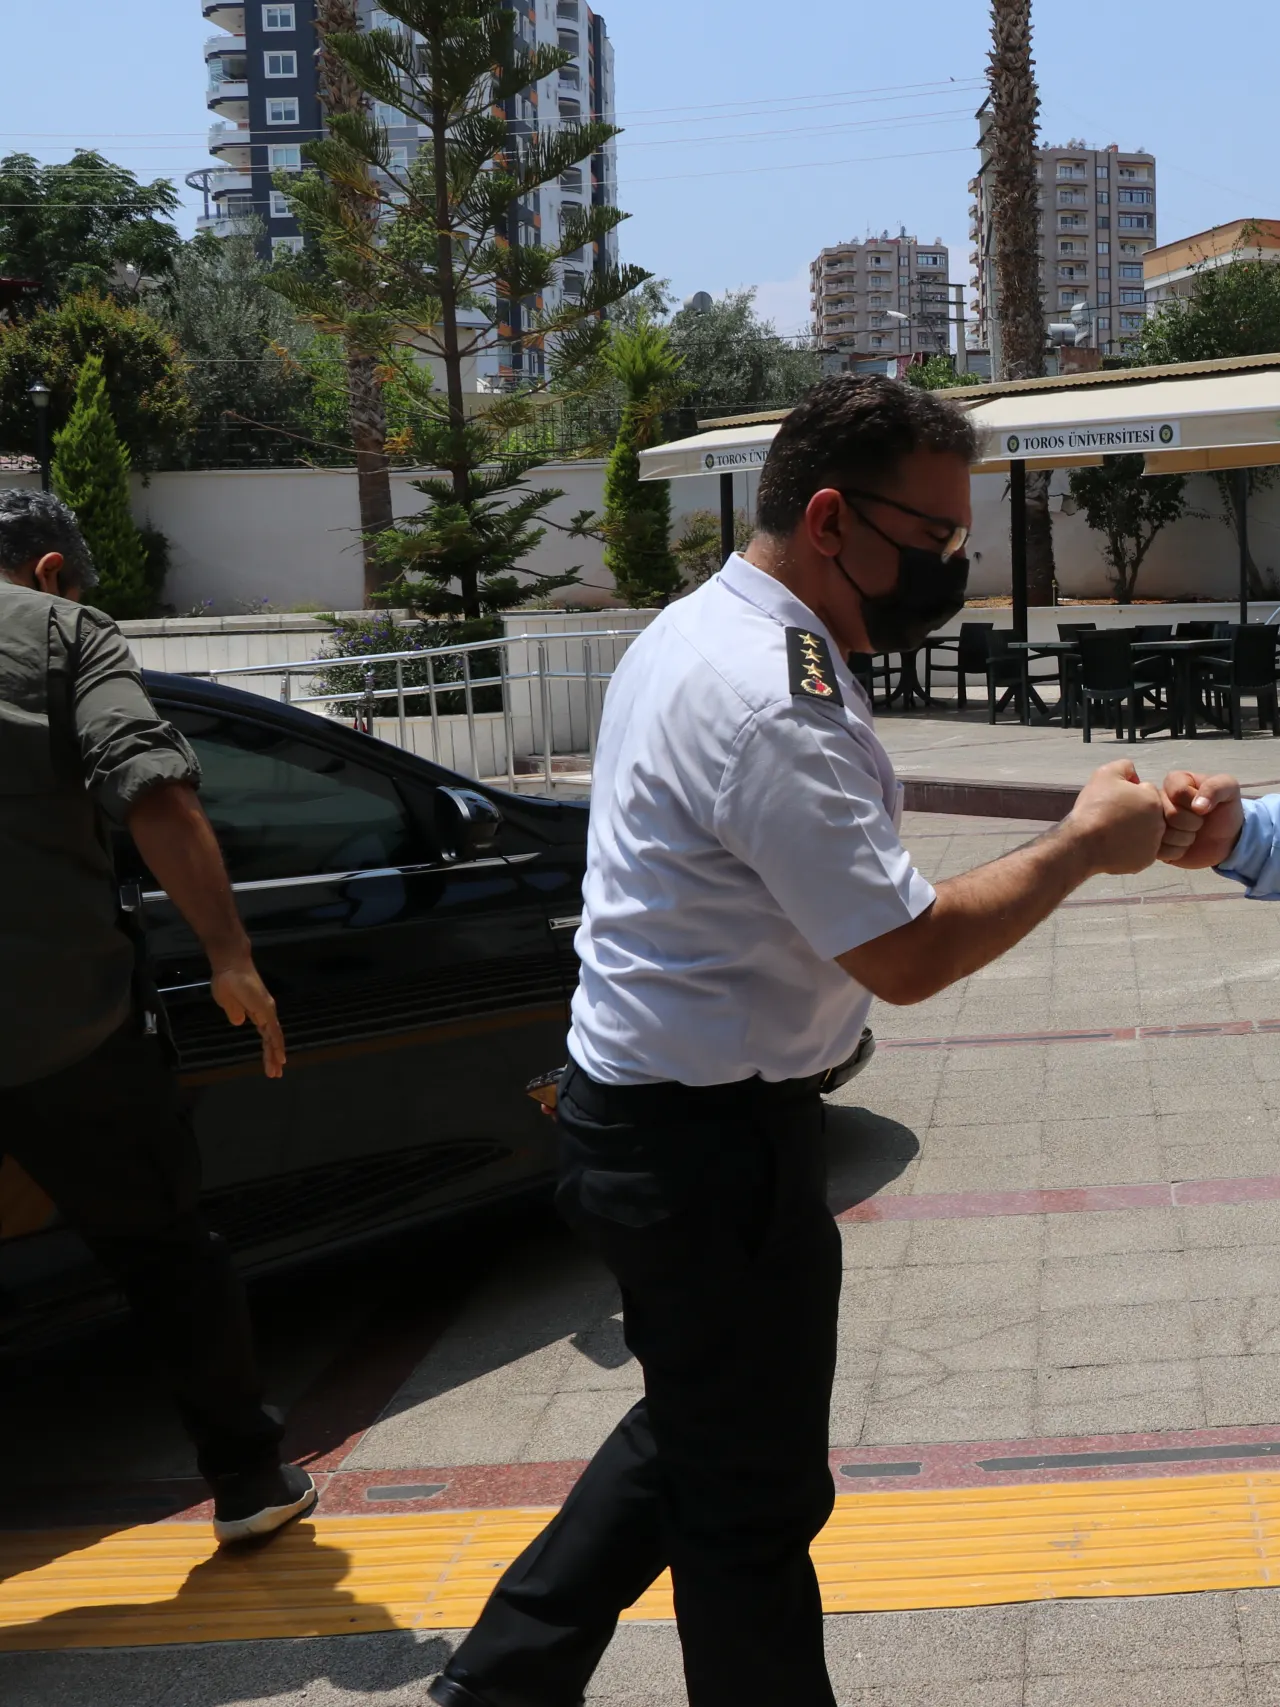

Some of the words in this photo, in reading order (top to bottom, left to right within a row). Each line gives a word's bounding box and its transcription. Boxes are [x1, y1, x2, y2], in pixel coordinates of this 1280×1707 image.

[1023, 435, 1064, 450] TOROS
[1068, 425, 1155, 447] ÜNİVERSİTESİ
[716, 453, 747, 466] TOROS
